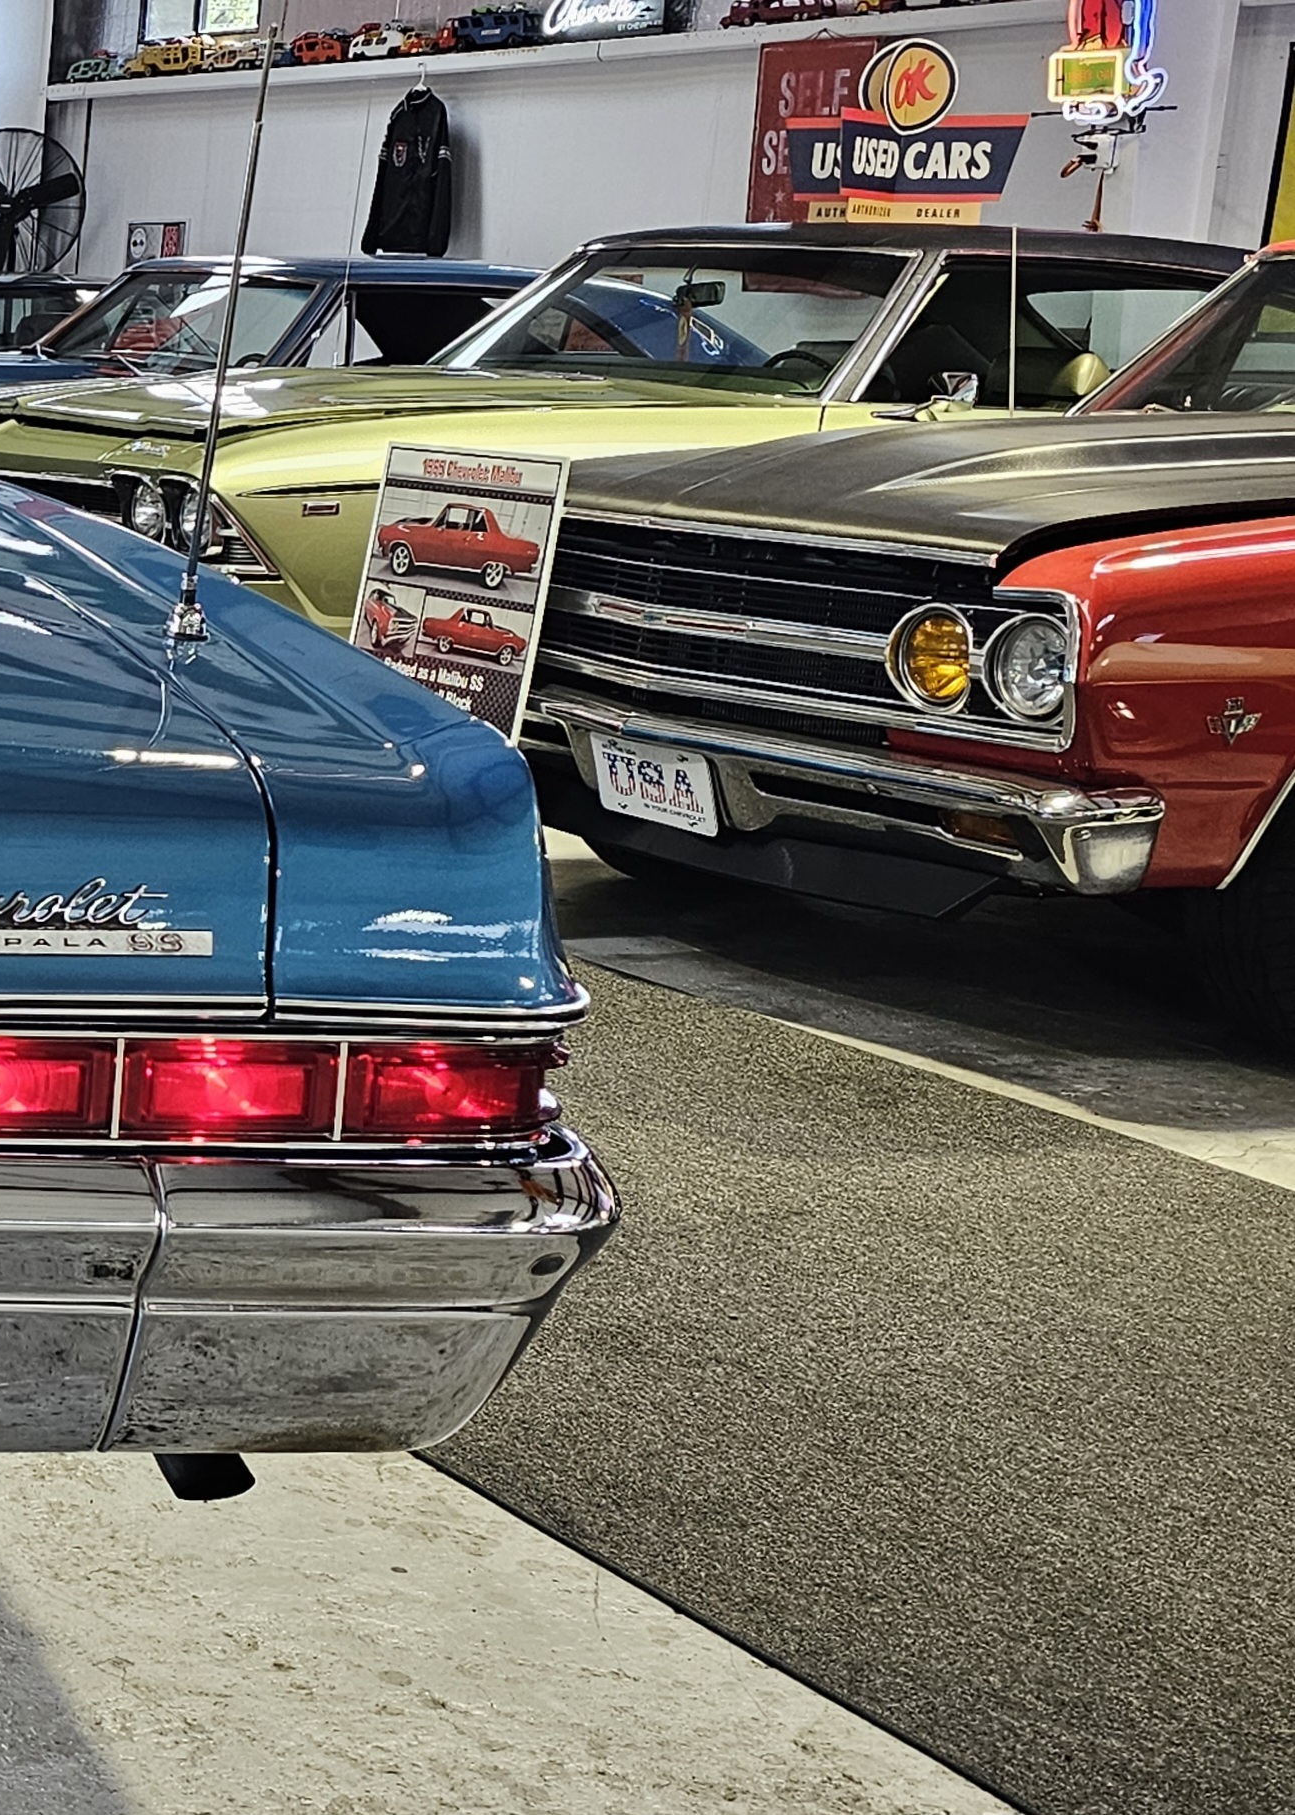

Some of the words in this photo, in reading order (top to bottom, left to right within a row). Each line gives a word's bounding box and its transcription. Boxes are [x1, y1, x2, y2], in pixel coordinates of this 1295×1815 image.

[778, 68, 851, 118] SELF
[895, 58, 938, 109] OK
[852, 136, 900, 179] USED
[903, 140, 992, 180] CARS
[851, 203, 892, 218] AUTHORIZED
[916, 208, 961, 218] DEALER
[447, 460, 490, 482] Chevrolet
[491, 464, 523, 487] Malibu
[417, 667, 429, 679] as
[429, 670, 436, 682] a
[436, 667, 469, 687] Malibu
[470, 674, 485, 692] SS
[602, 751, 704, 814] USA
[126, 932, 184, 953] SS
